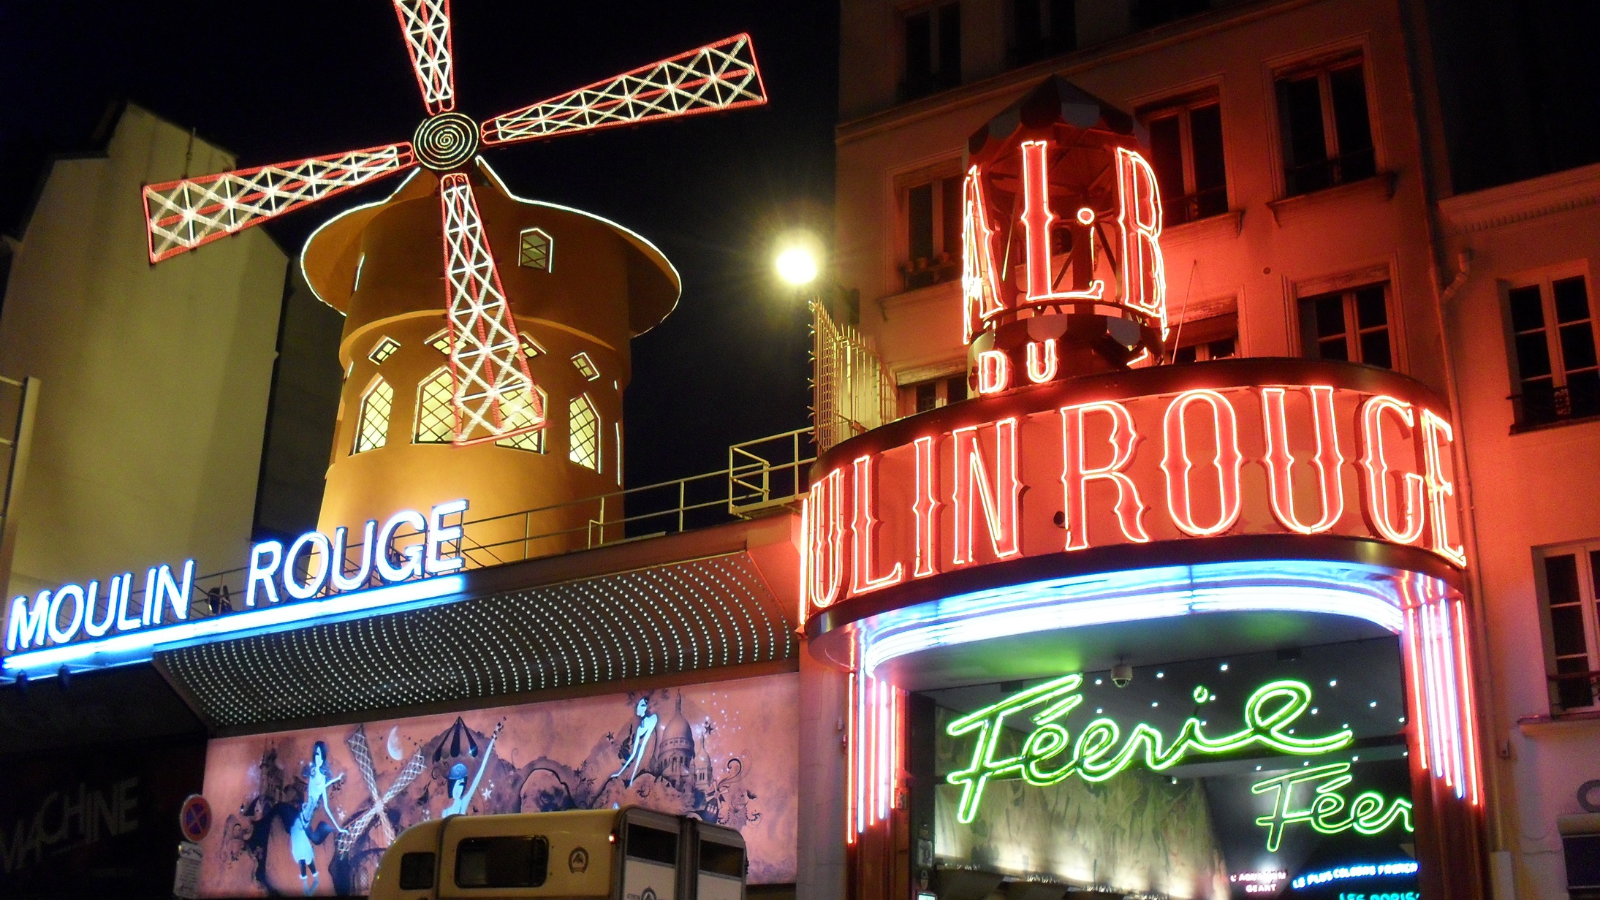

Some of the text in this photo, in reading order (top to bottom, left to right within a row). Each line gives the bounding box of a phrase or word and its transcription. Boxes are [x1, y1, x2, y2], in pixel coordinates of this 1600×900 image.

[977, 338, 1058, 394] DU
[1060, 386, 1467, 568] ROUGE
[6, 498, 469, 651] MOULIN ROUGE
[946, 672, 1355, 825] Féerie
